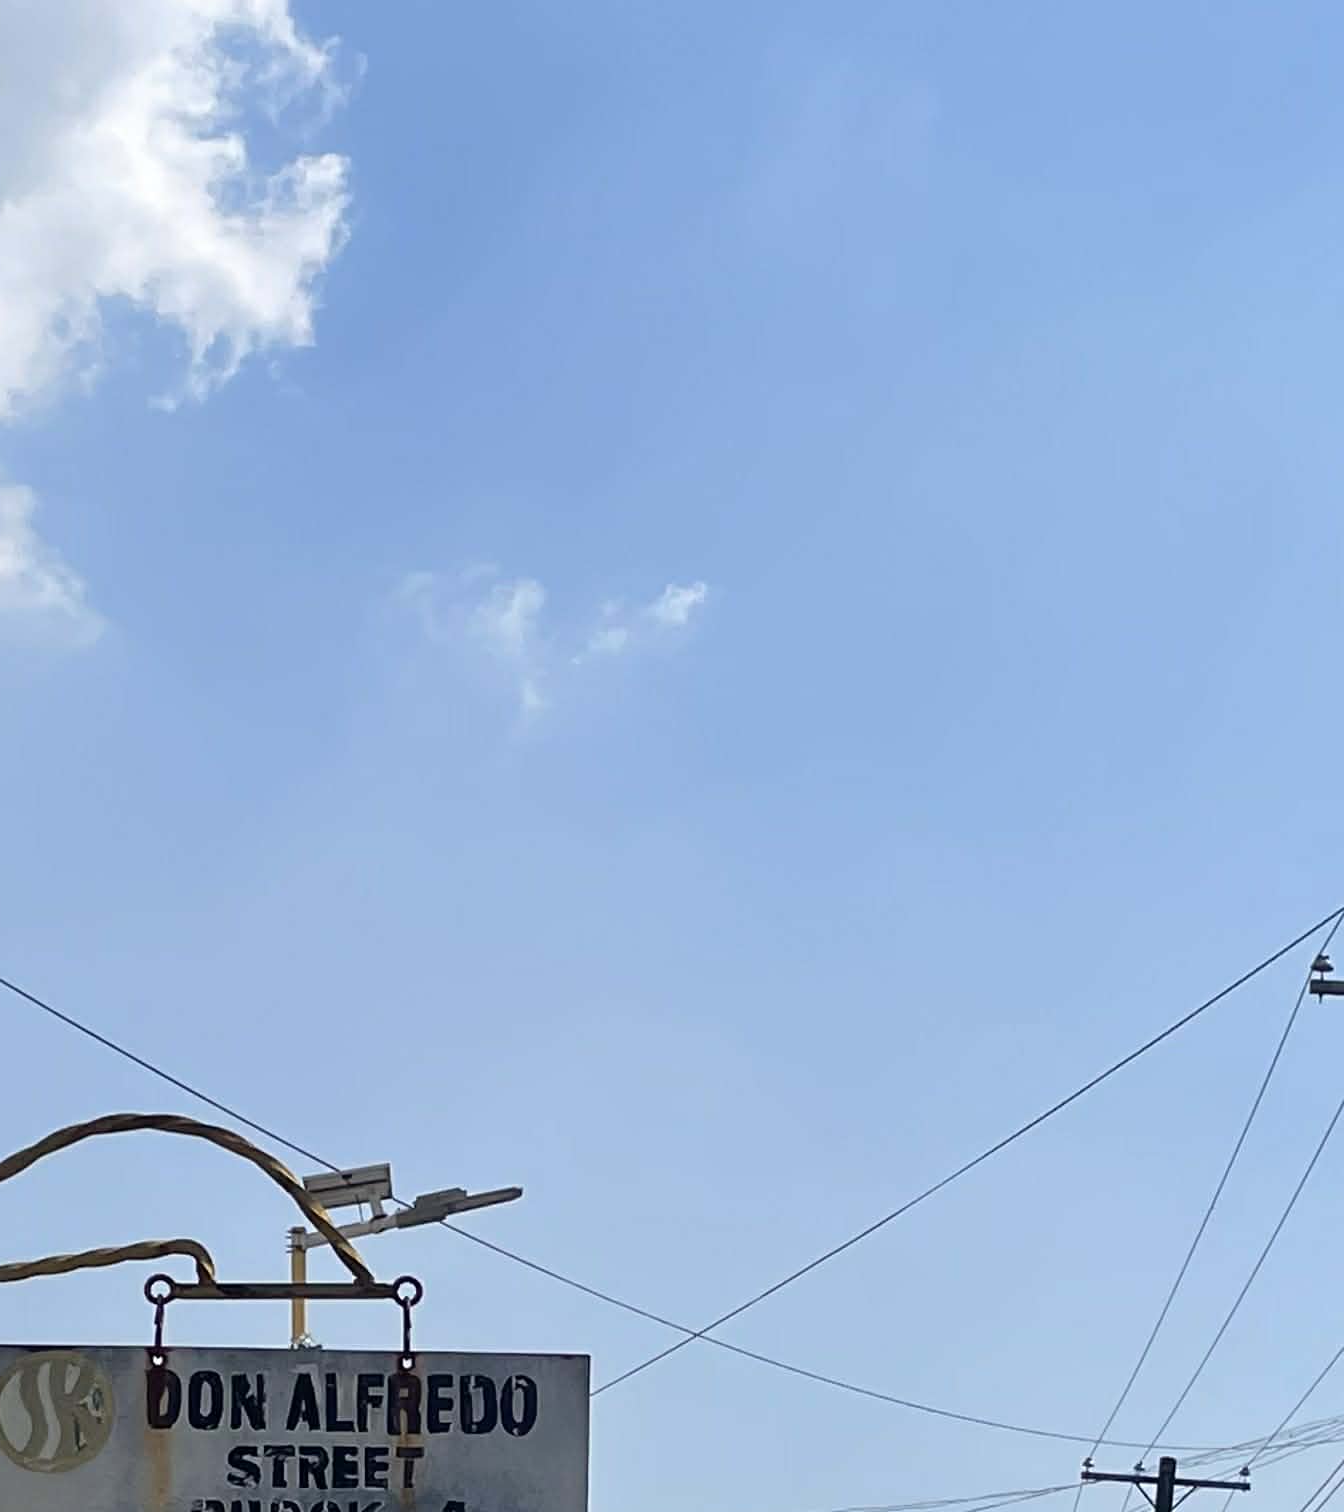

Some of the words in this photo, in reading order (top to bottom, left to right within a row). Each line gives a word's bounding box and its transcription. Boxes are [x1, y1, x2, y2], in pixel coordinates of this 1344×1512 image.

[145, 1368, 267, 1431] DON
[286, 1372, 538, 1437] ALFREDO
[226, 1444, 426, 1490] STREET
